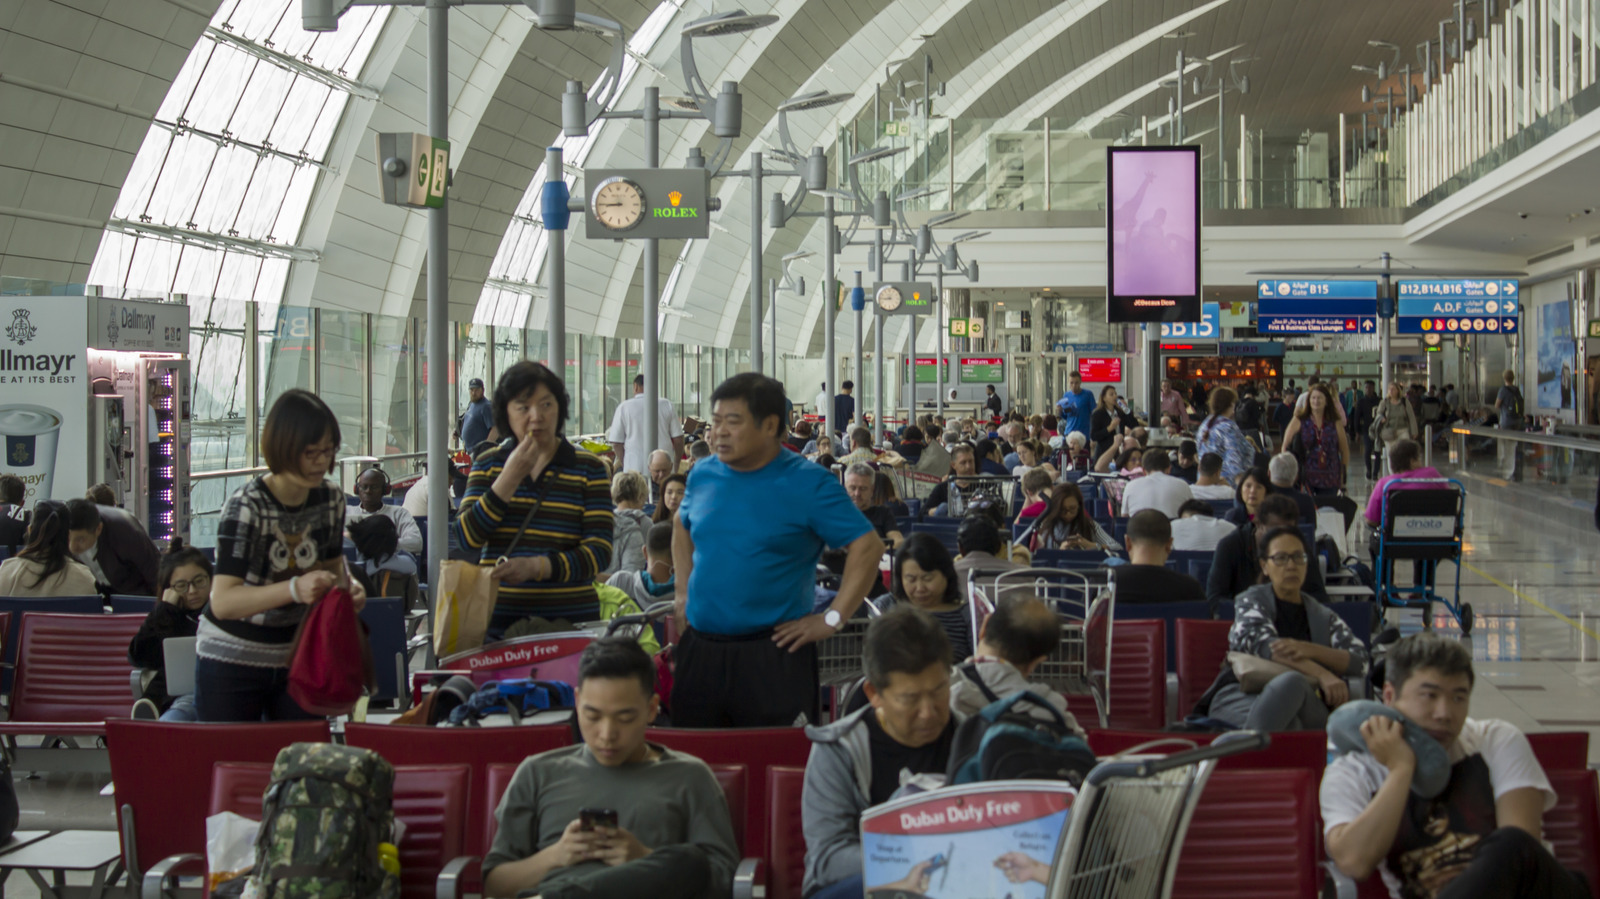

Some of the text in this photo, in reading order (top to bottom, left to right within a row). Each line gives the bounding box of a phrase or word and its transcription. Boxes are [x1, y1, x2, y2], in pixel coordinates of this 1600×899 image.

[653, 207, 698, 218] ROLEX
[1310, 284, 1329, 295] B15
[1400, 284, 1462, 295] B12,B14,B16
[122, 307, 155, 334] Dallmayr
[1322, 324, 1344, 332] Lounges
[1406, 519, 1442, 528] dnata
[469, 645, 559, 668] Dubai Duty Free
[900, 800, 1021, 830] Dubai Duty Free
